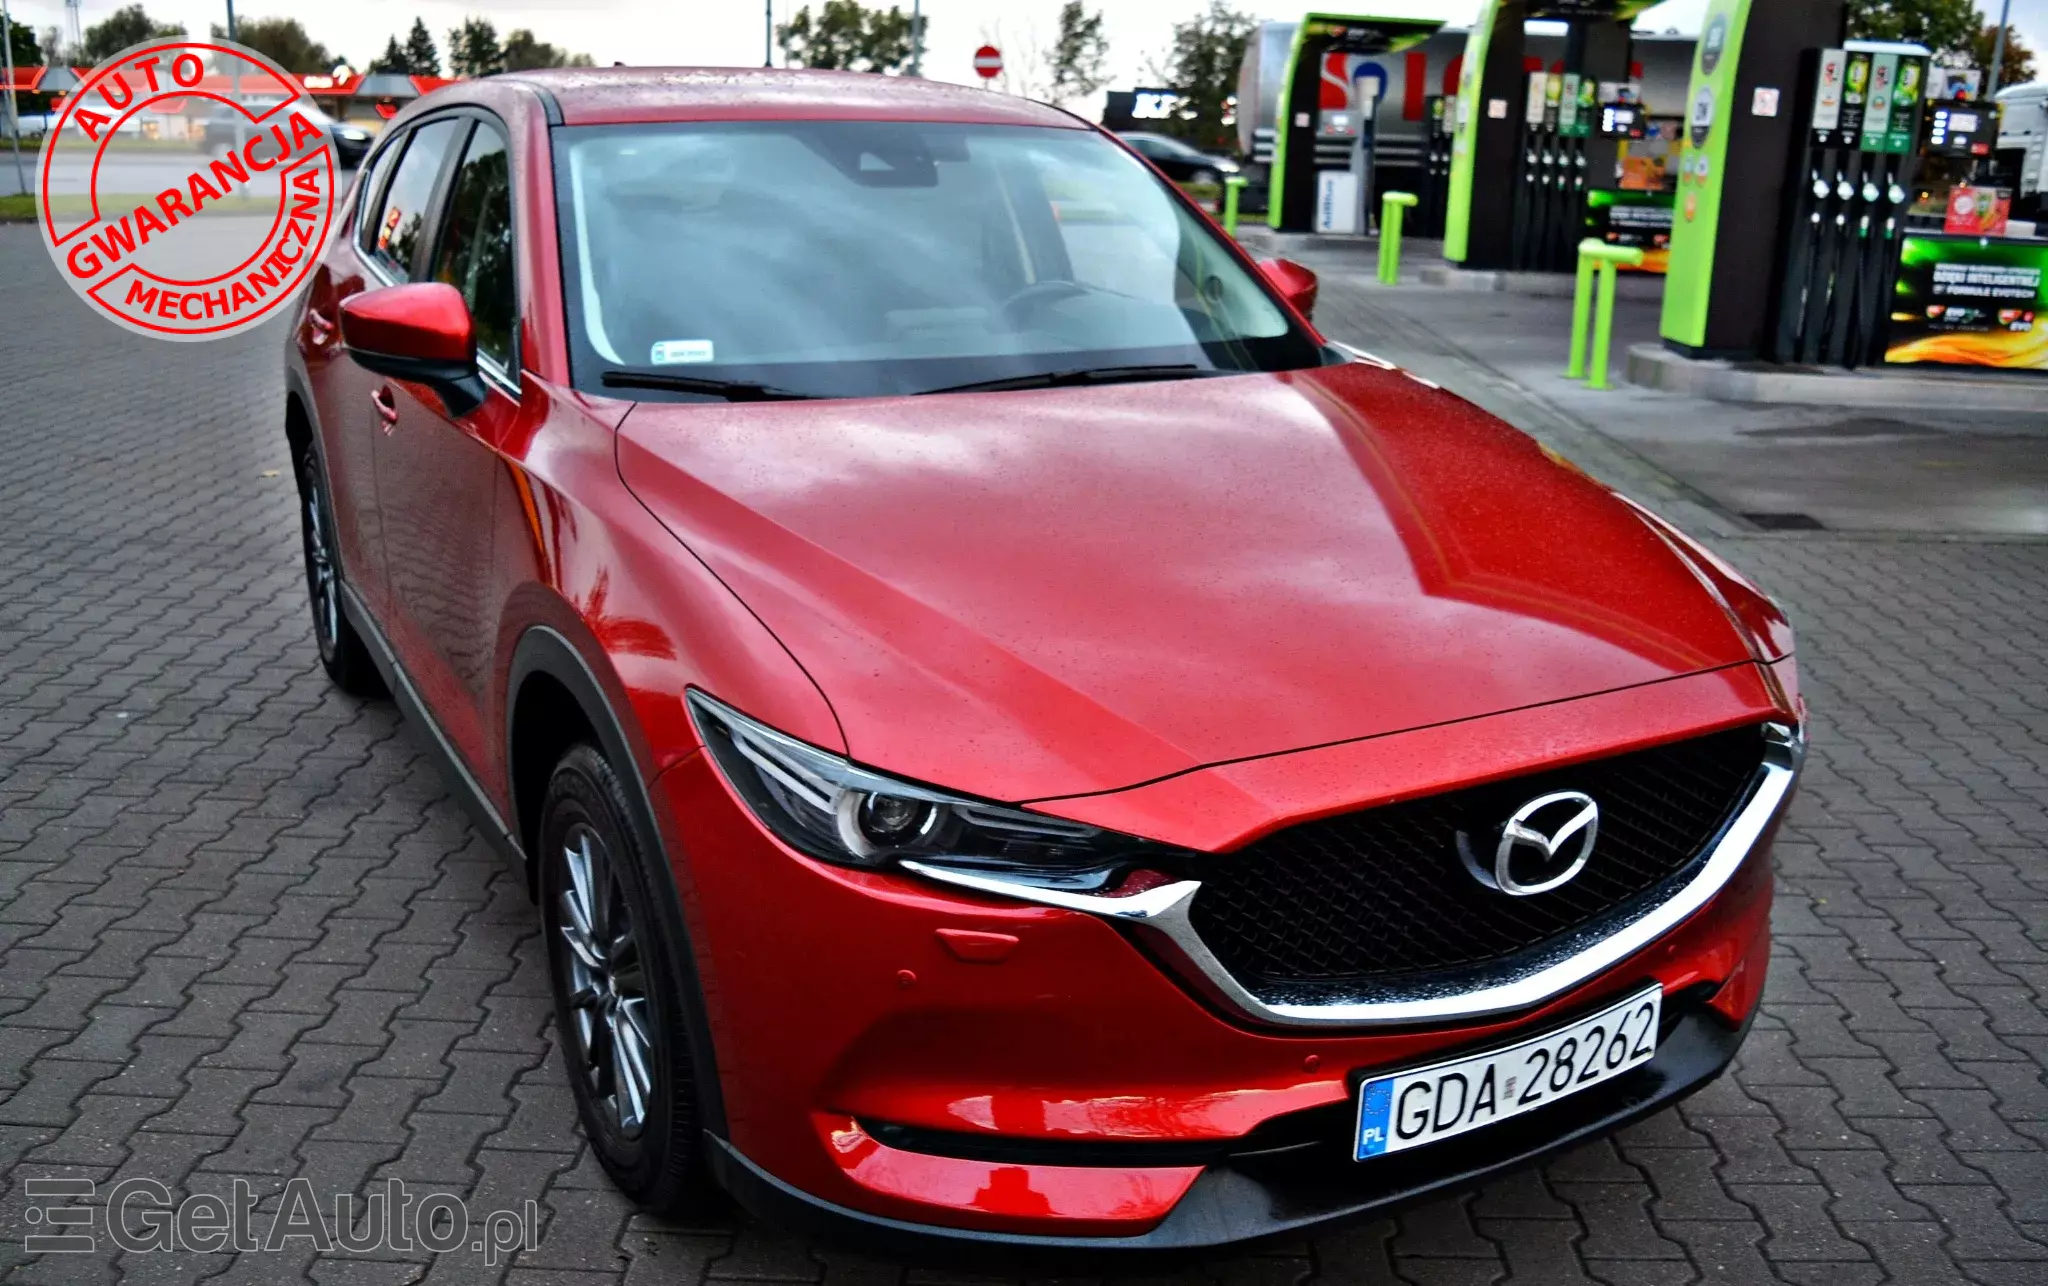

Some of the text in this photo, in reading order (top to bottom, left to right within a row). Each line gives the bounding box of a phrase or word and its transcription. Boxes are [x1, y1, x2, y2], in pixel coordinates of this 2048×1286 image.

[1395, 1001, 1655, 1140] GDA 28262
[1362, 1126, 1385, 1145] PL
